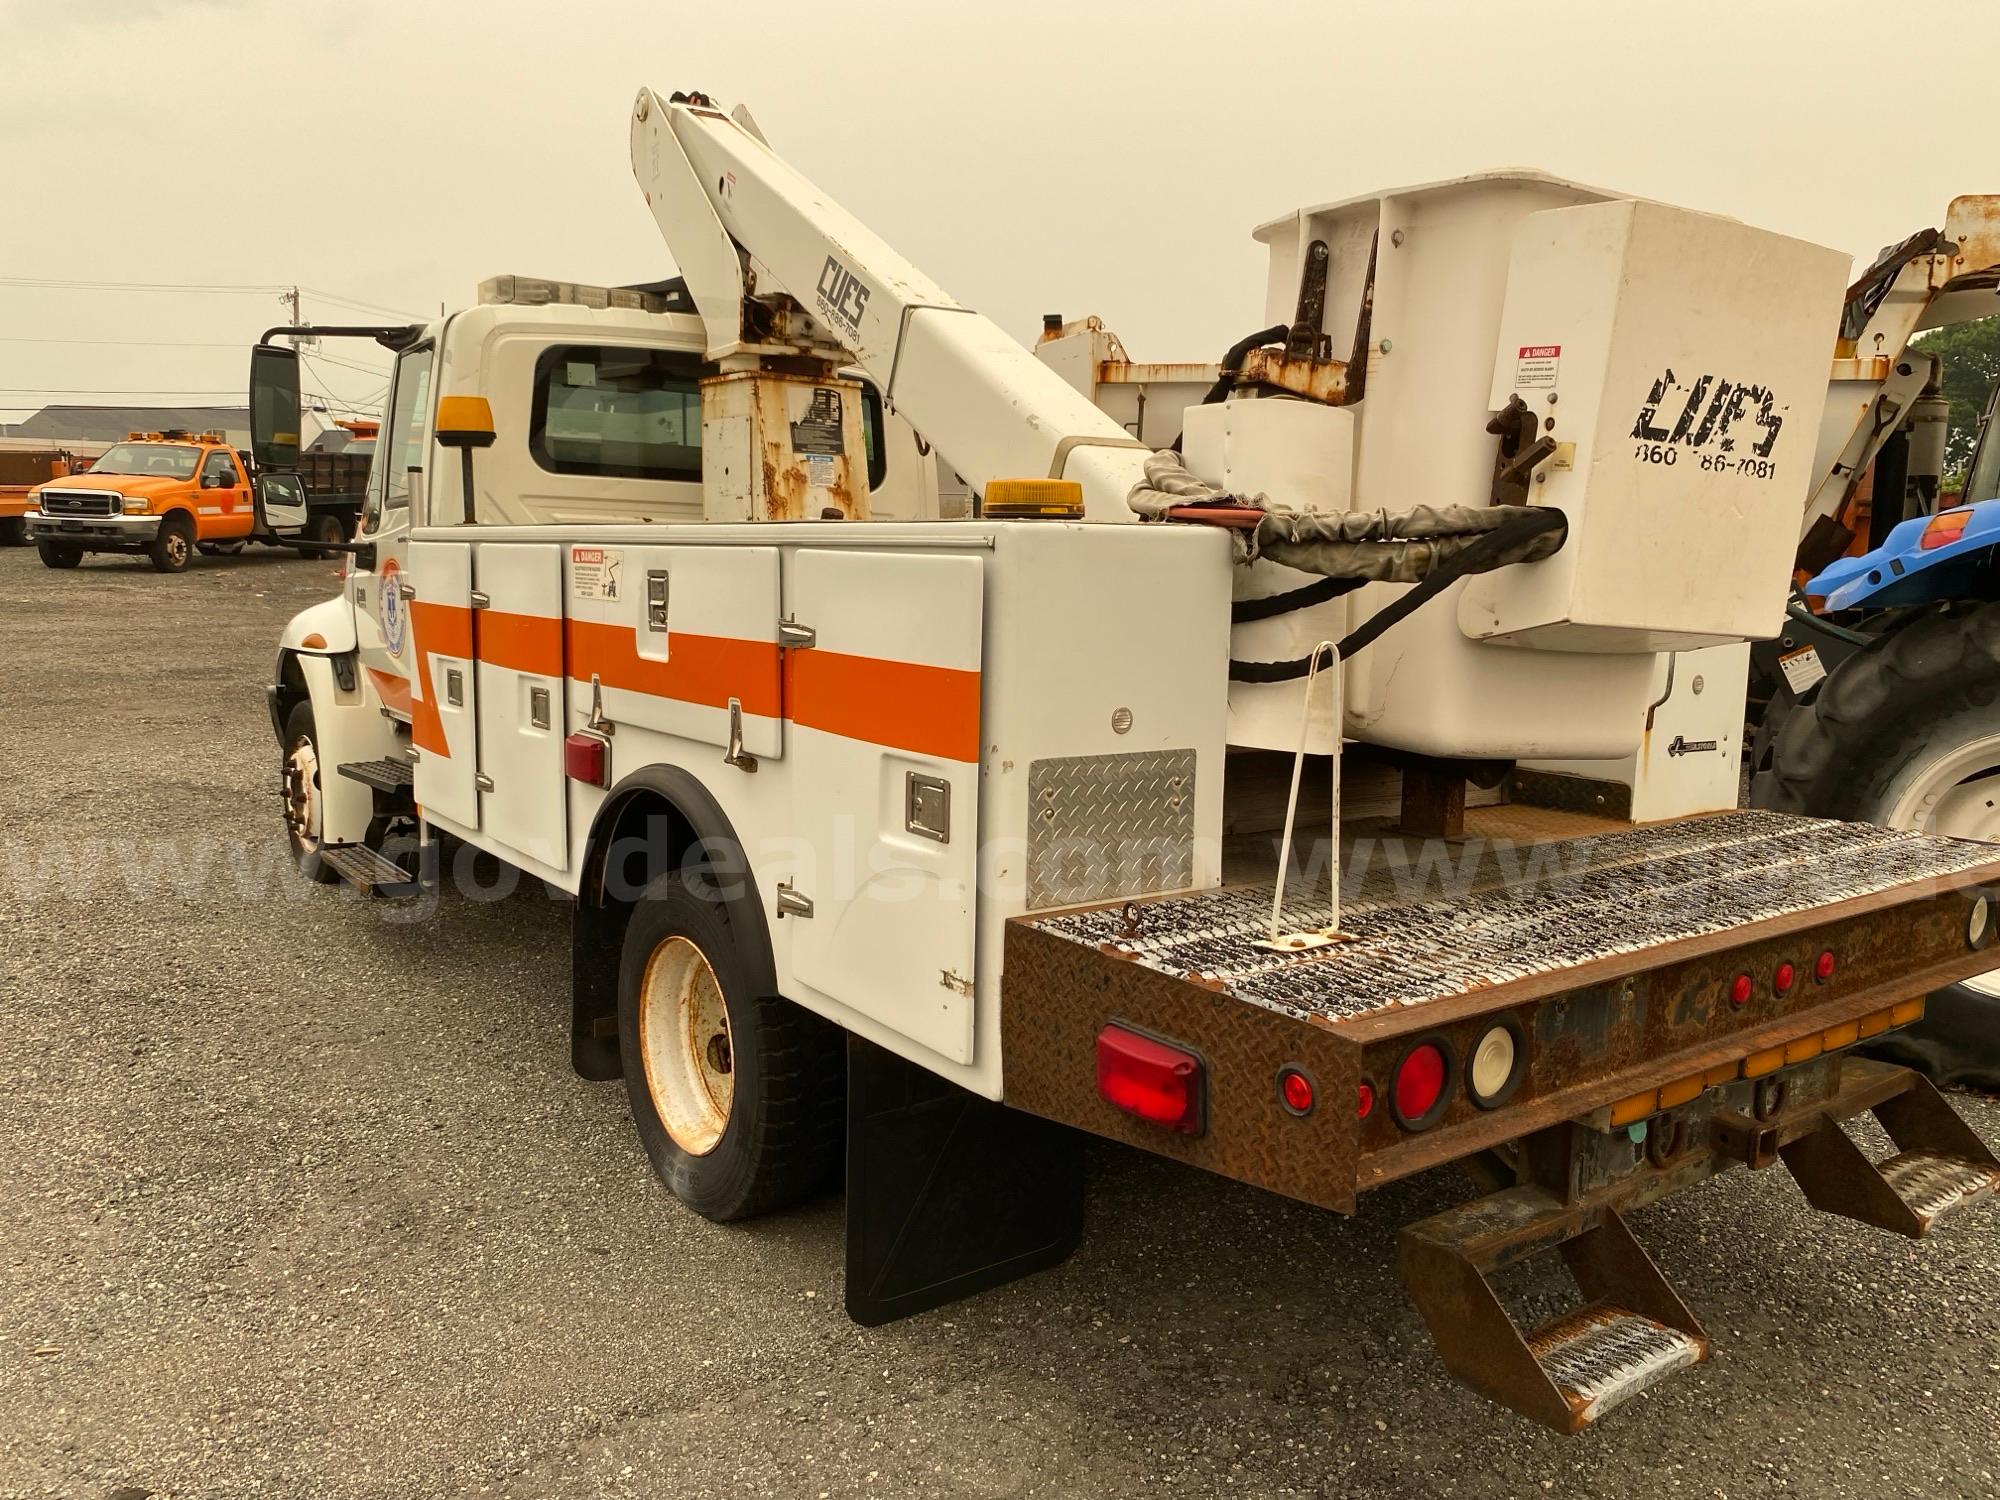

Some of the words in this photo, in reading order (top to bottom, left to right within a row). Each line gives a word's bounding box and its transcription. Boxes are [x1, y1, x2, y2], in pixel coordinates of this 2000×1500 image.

[816, 255, 871, 329] CUES
[1532, 347, 1556, 357] DANGER
[580, 551, 602, 562] DANGER
